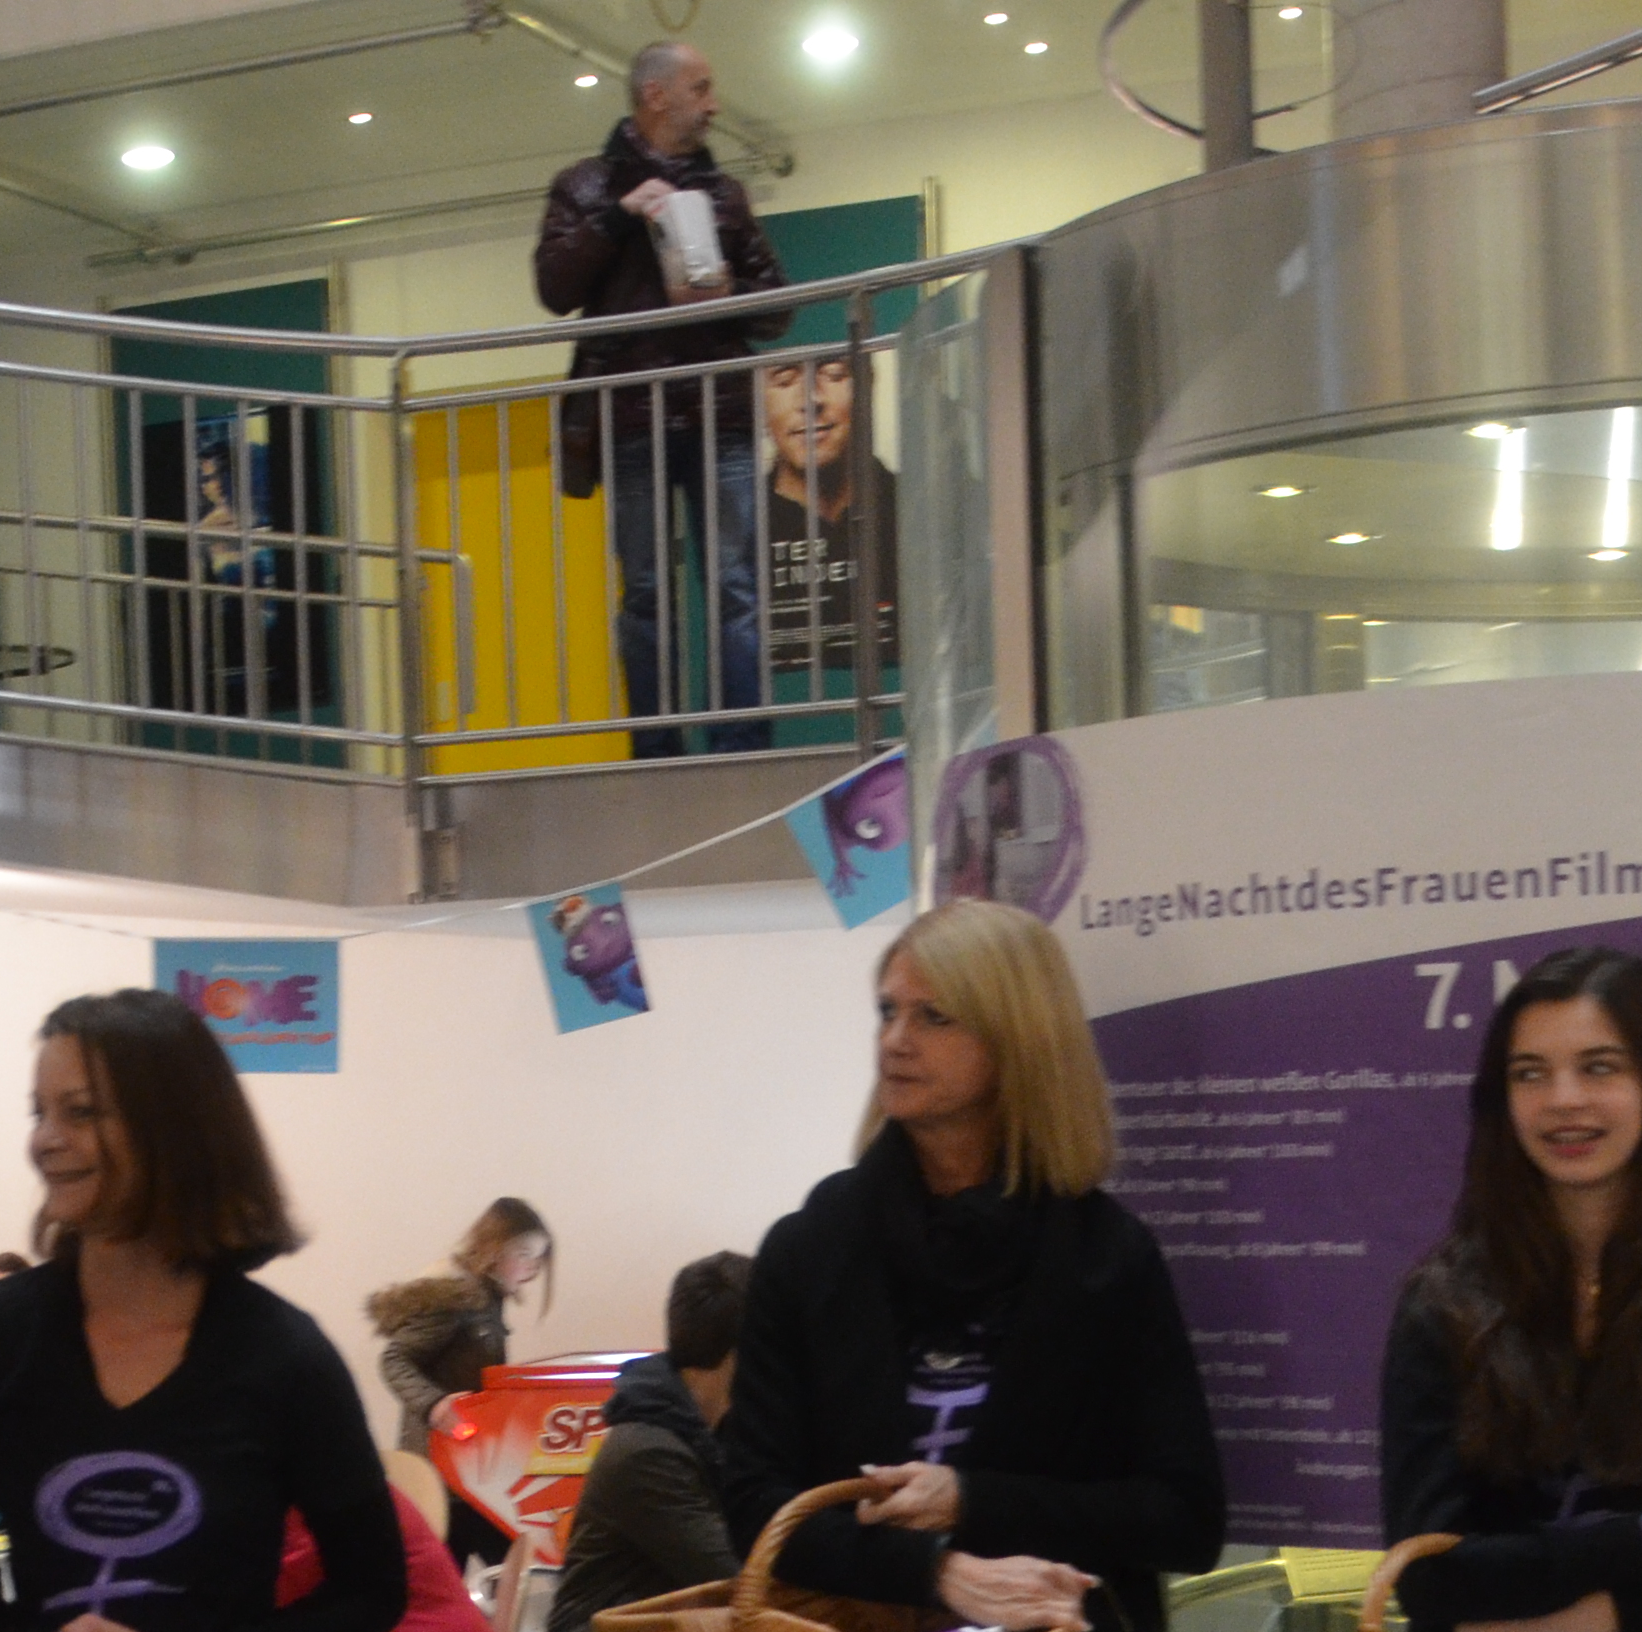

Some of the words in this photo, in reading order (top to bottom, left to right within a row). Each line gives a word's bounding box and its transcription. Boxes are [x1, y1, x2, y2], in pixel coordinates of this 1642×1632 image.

[771, 538, 828, 562] TER
[175, 969, 320, 1026] HOME
[1414, 961, 1473, 1030] 7.
[538, 1405, 614, 1453] SP
